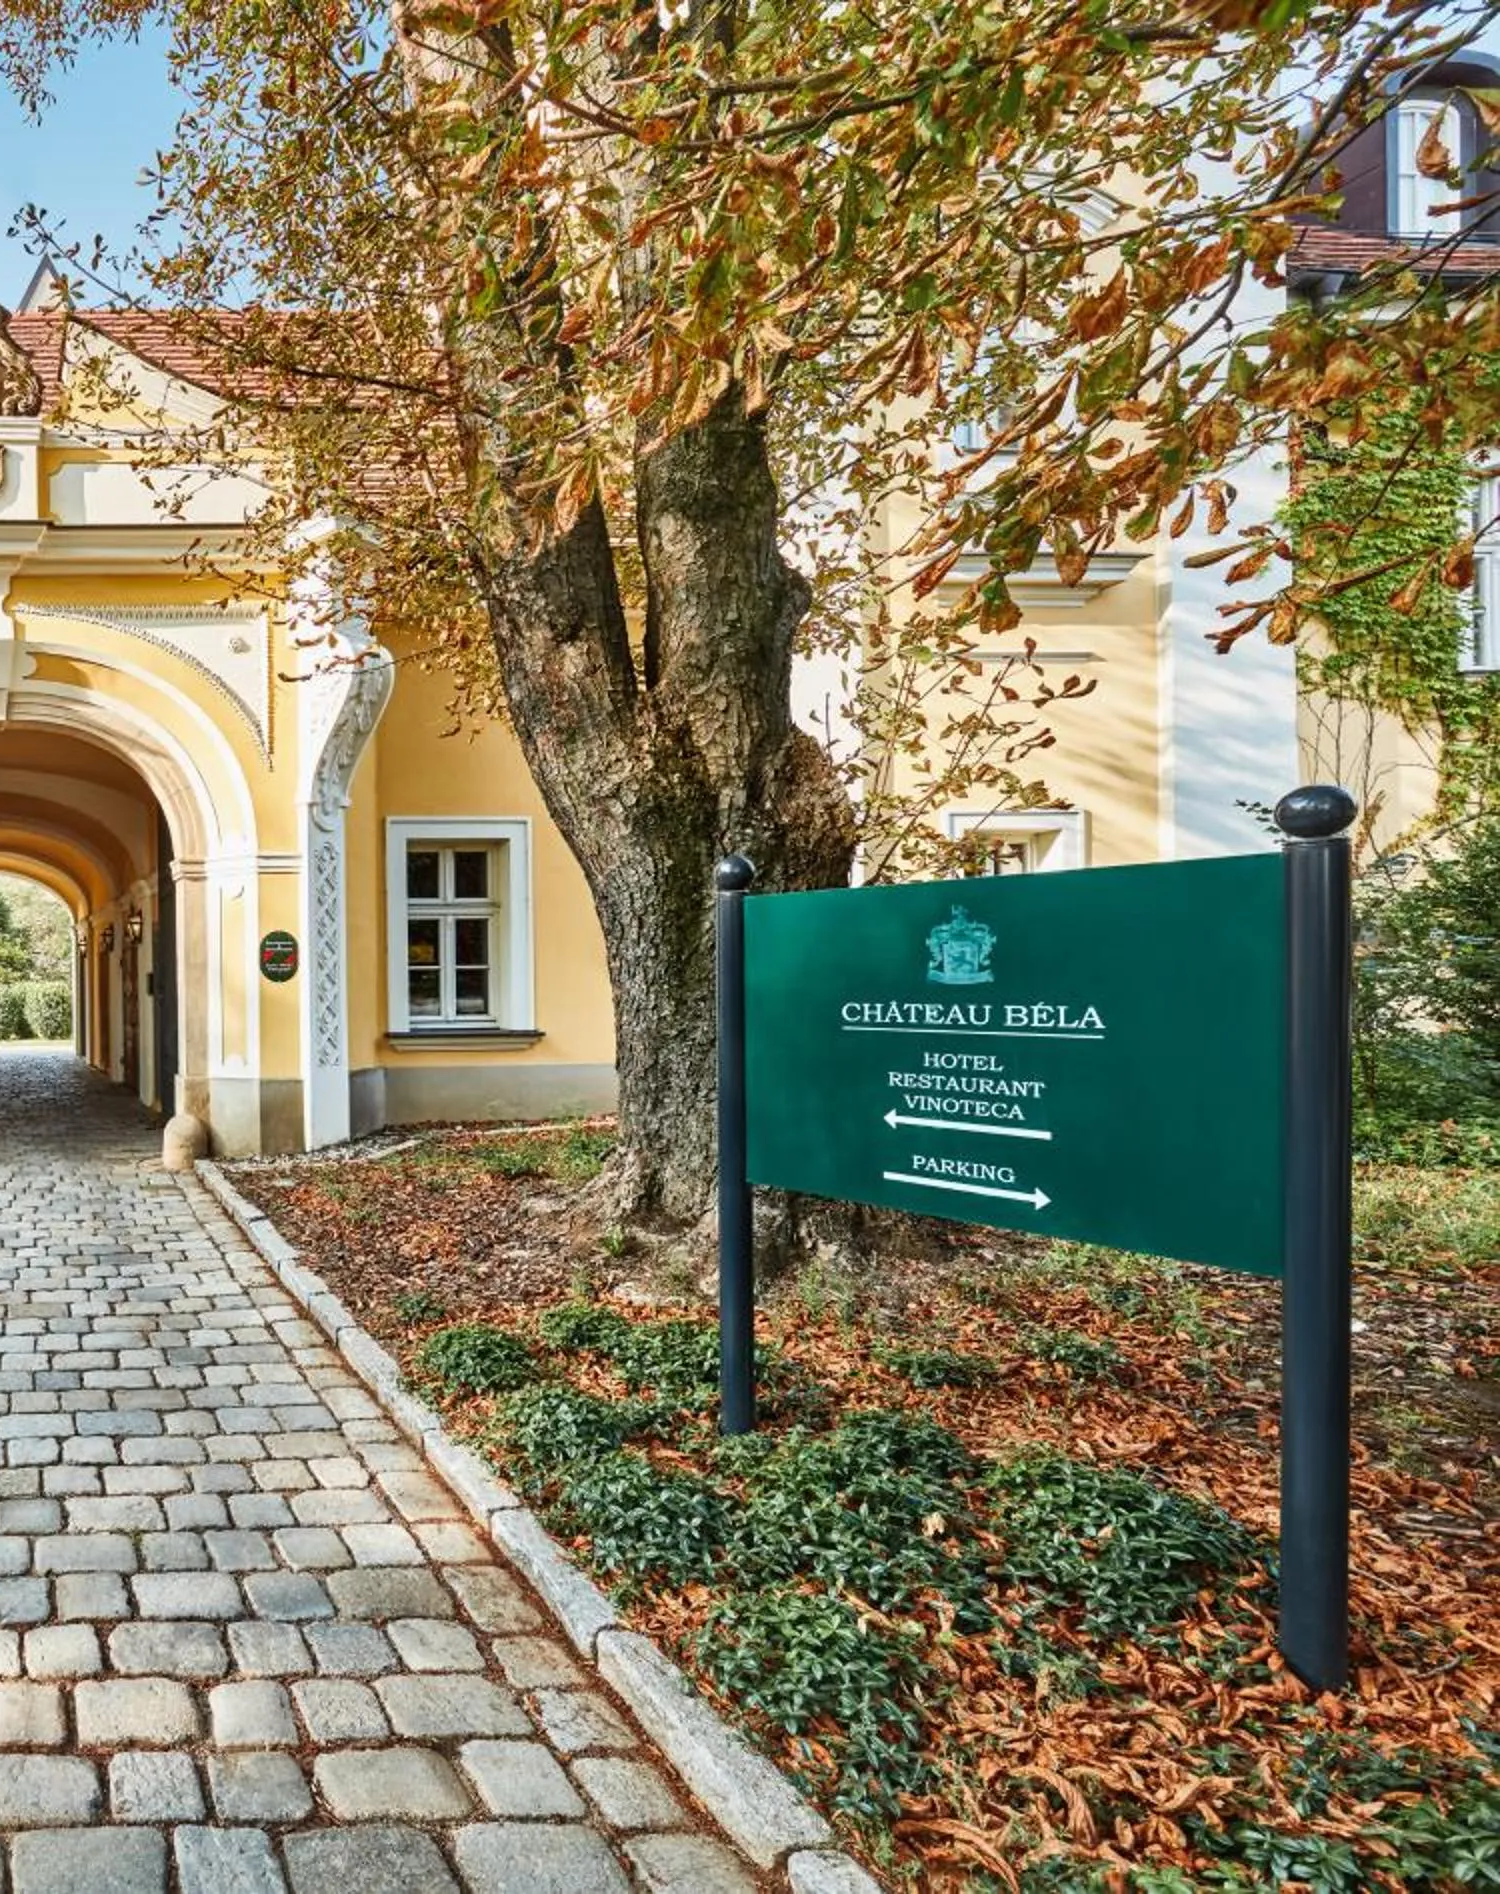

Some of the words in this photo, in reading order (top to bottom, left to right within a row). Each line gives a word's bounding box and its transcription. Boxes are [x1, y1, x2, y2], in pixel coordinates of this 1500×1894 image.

[841, 1001, 992, 1025] CHÂTEAU
[1004, 1002, 1106, 1029] BÉLA
[923, 1052, 1004, 1072] HOTEL
[888, 1072, 1046, 1099] RESTAURANT
[905, 1094, 1025, 1121] VINOTECA
[912, 1155, 1016, 1183] PARKING
